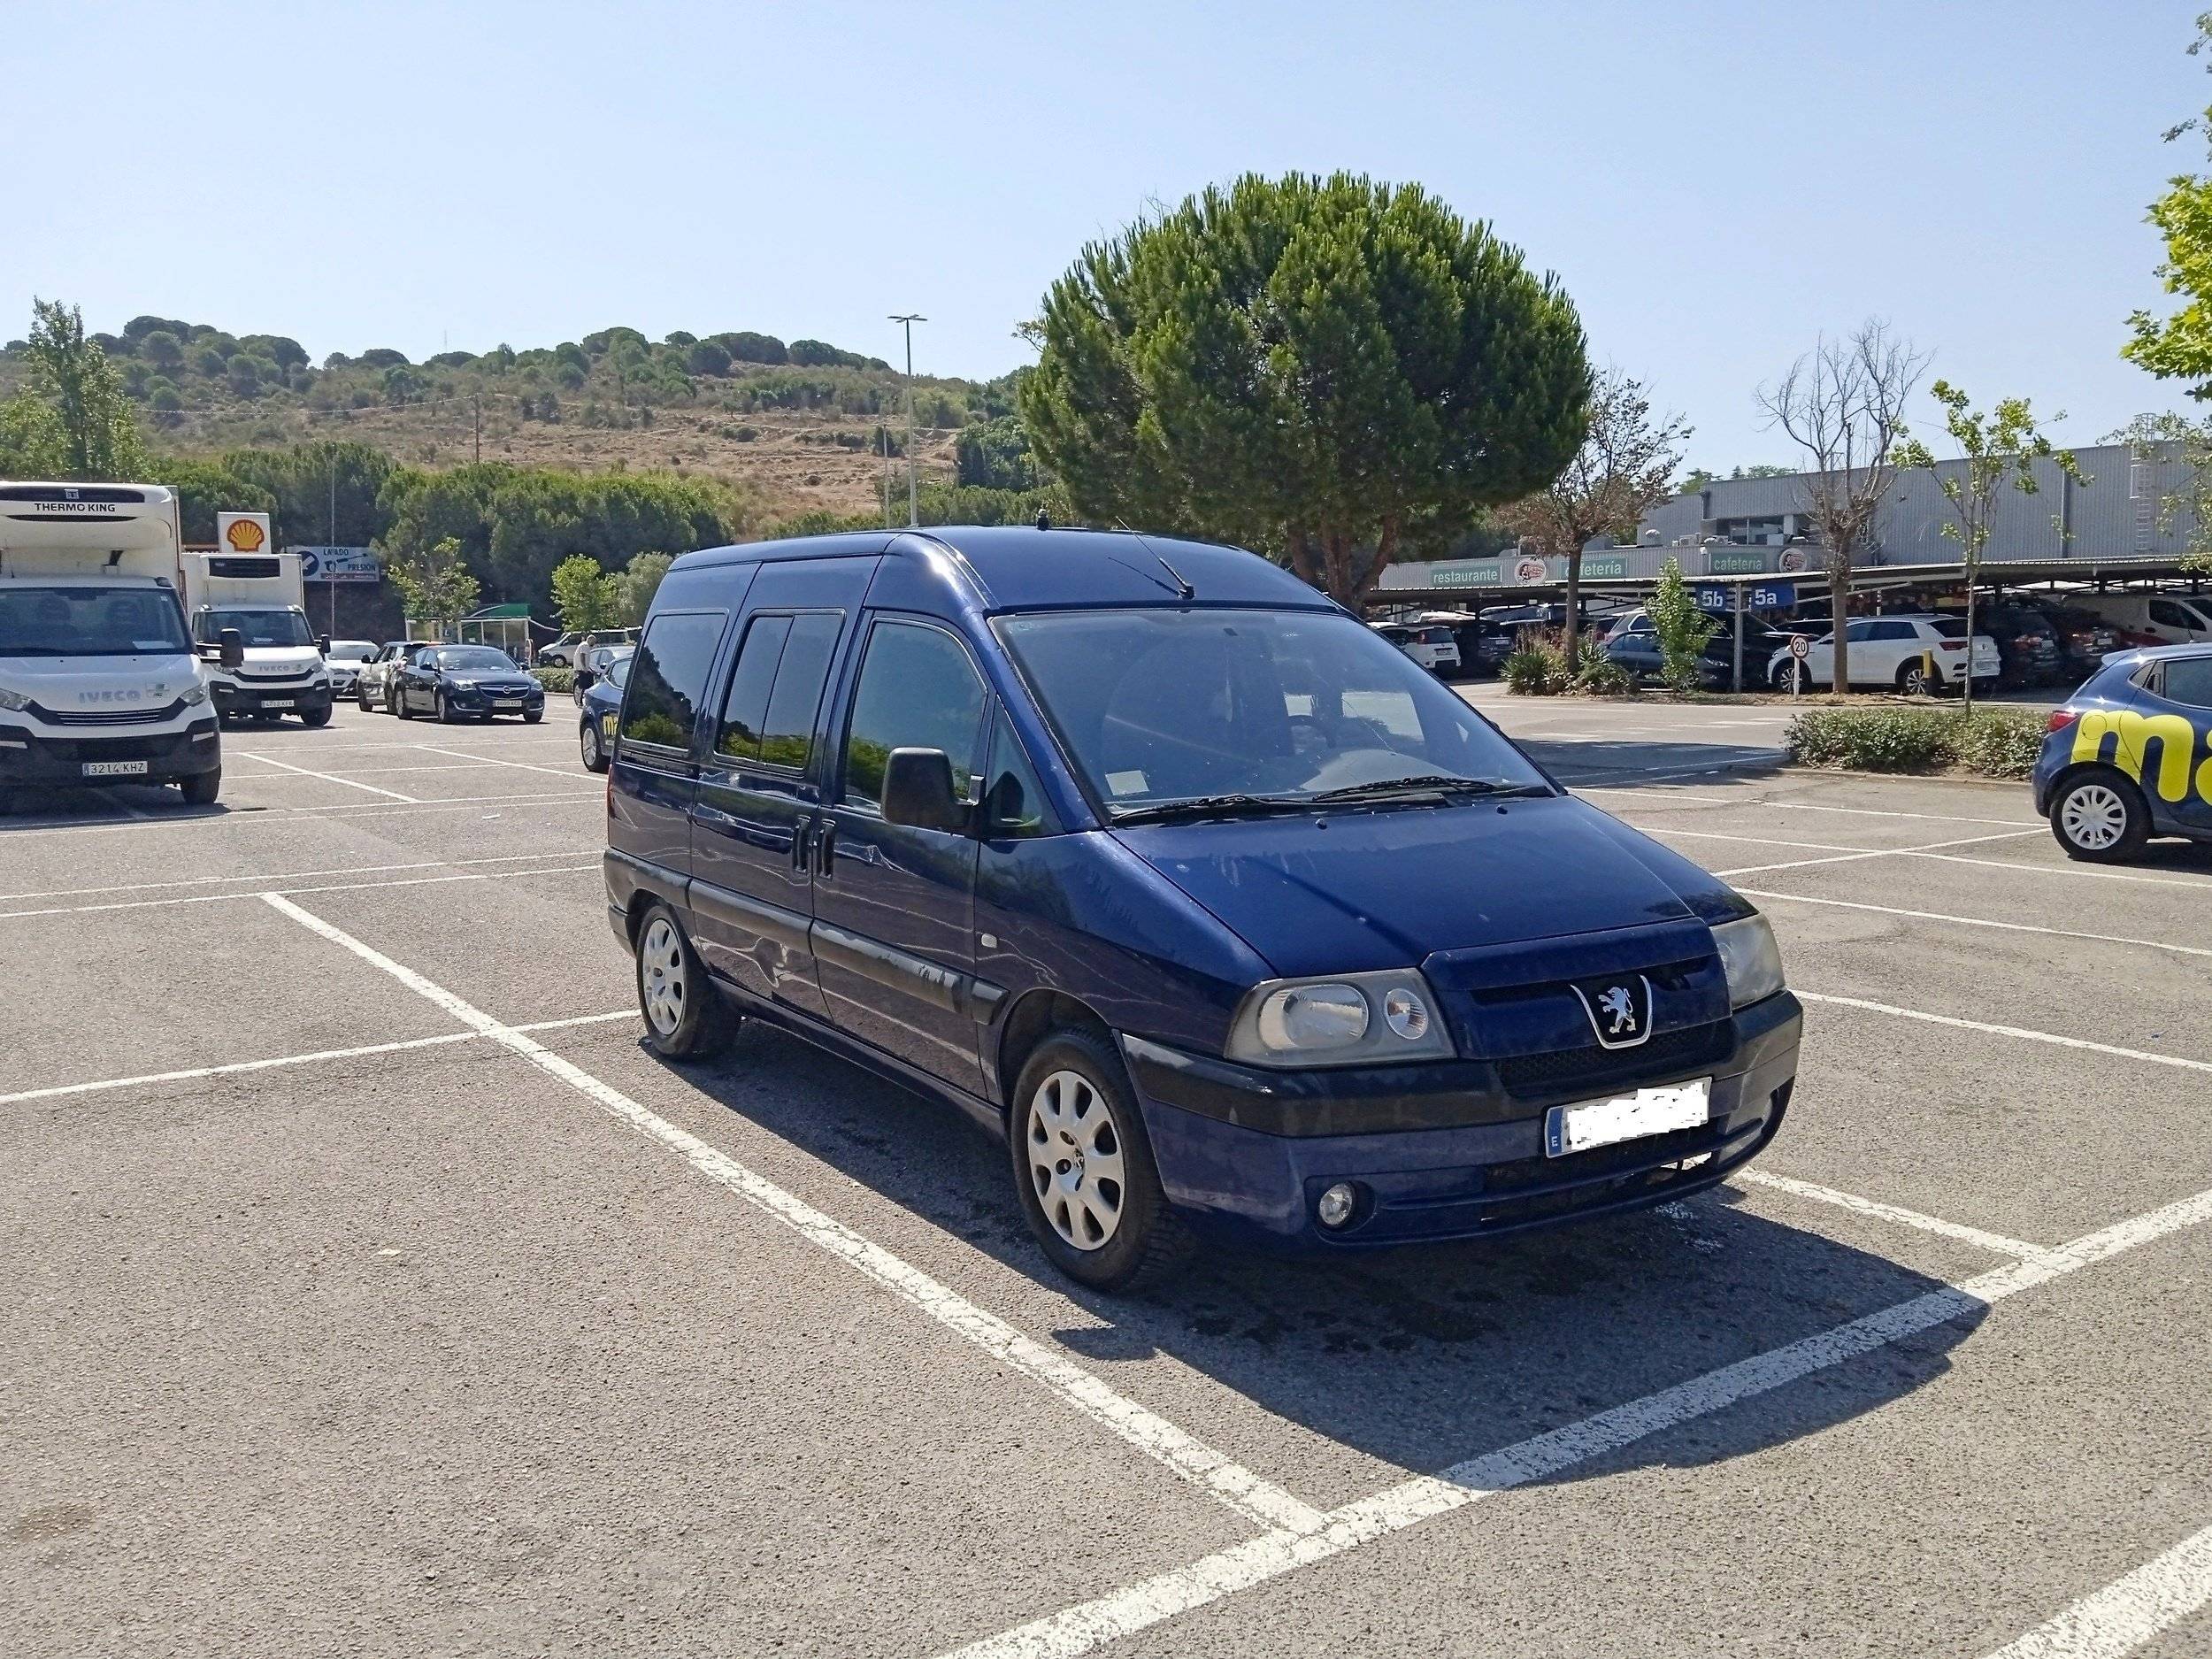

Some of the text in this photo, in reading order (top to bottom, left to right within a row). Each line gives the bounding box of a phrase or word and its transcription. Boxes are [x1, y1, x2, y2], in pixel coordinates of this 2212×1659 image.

[35, 503, 116, 512] THERMO KING
[1564, 560, 1622, 577] cfetería
[1433, 569, 1497, 583] restaurante
[1701, 590, 1724, 607] 5b
[1755, 588, 1777, 606] 5a
[1794, 641, 1806, 652] 20
[80, 690, 142, 703] IVECO
[91, 762, 144, 774] 3214 KHZ
[1551, 1135, 1558, 1148] E
